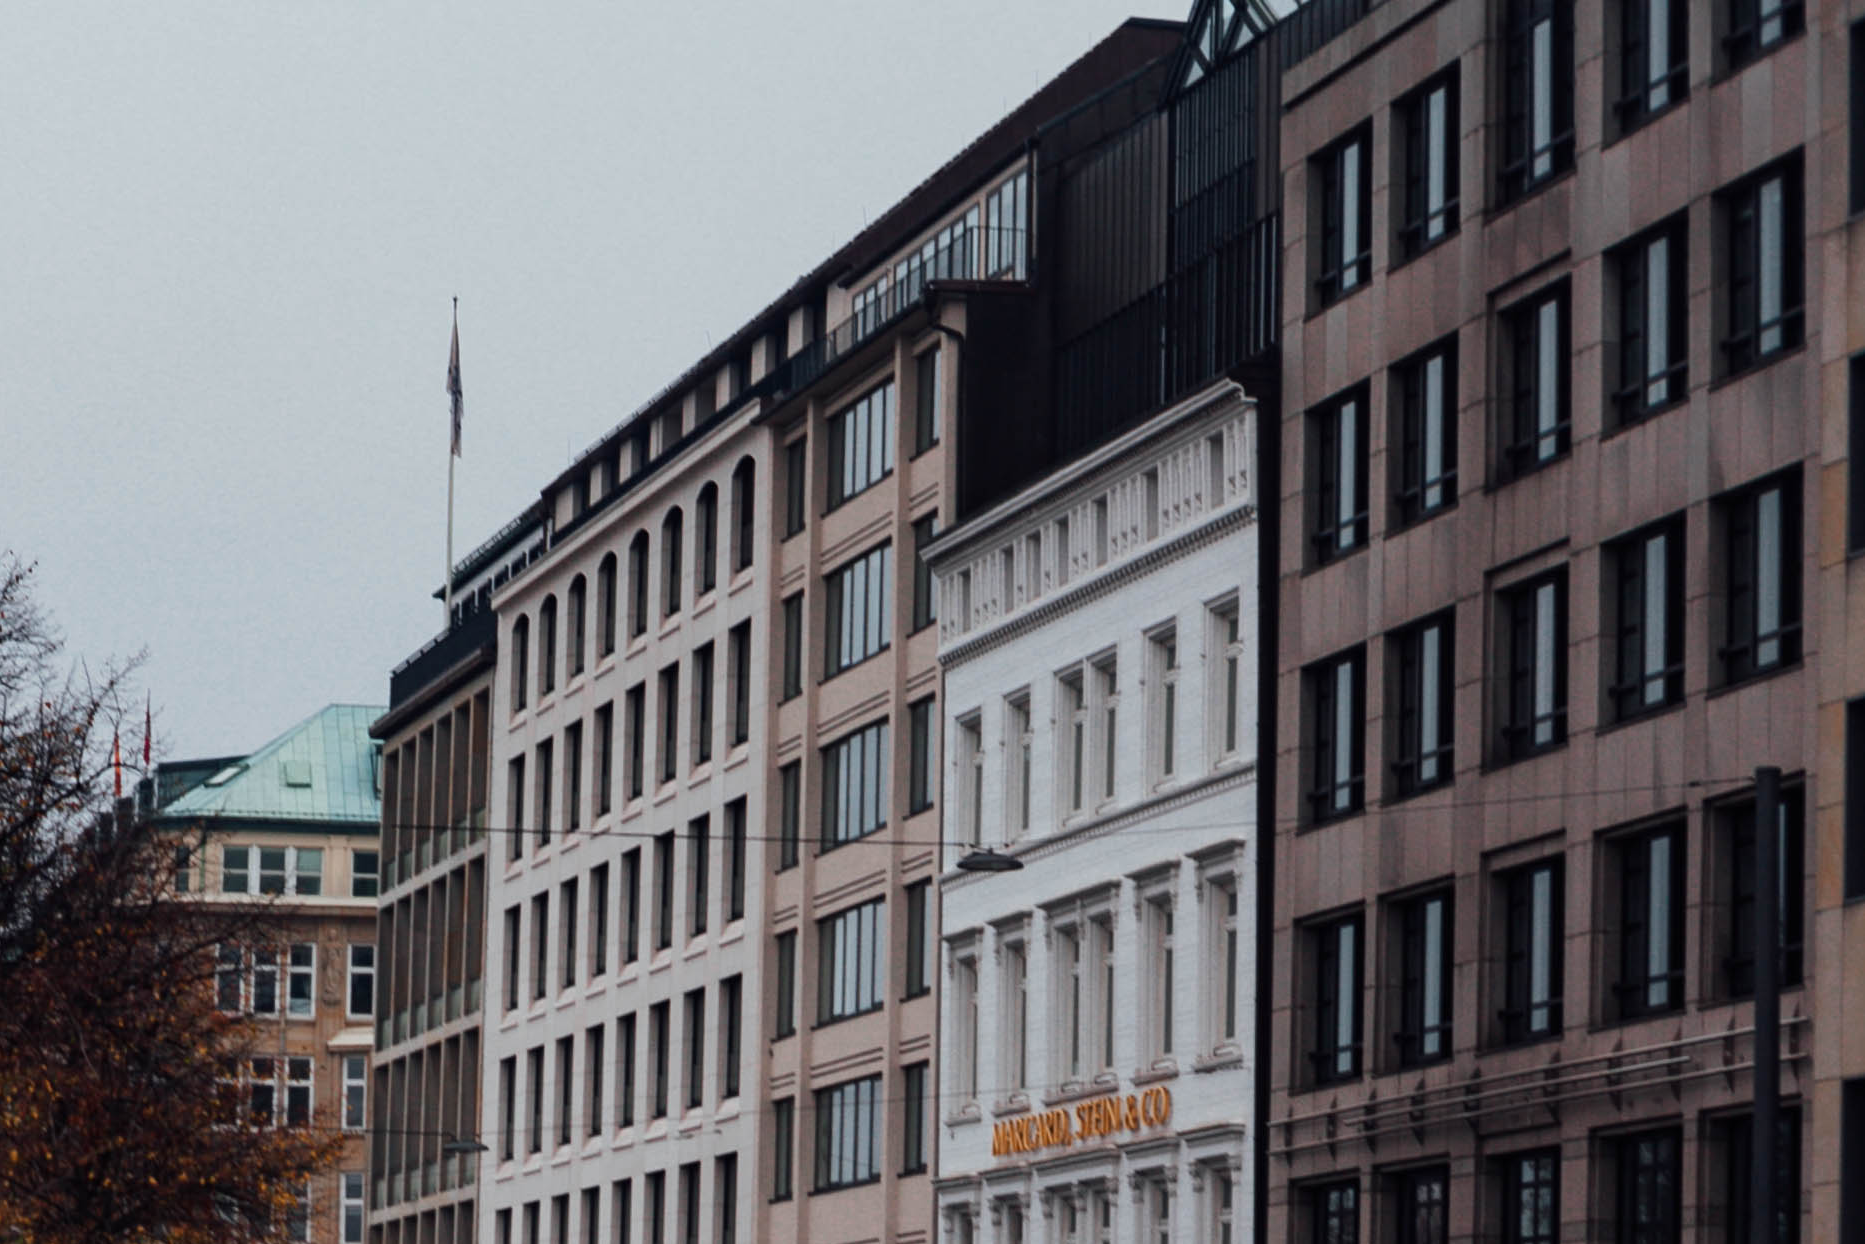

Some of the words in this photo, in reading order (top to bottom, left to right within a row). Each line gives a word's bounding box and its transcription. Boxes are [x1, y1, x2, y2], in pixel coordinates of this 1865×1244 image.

[992, 1108, 1072, 1156] MARCARD,
[1075, 1096, 1121, 1141] STEIN
[1125, 1095, 1139, 1130] &
